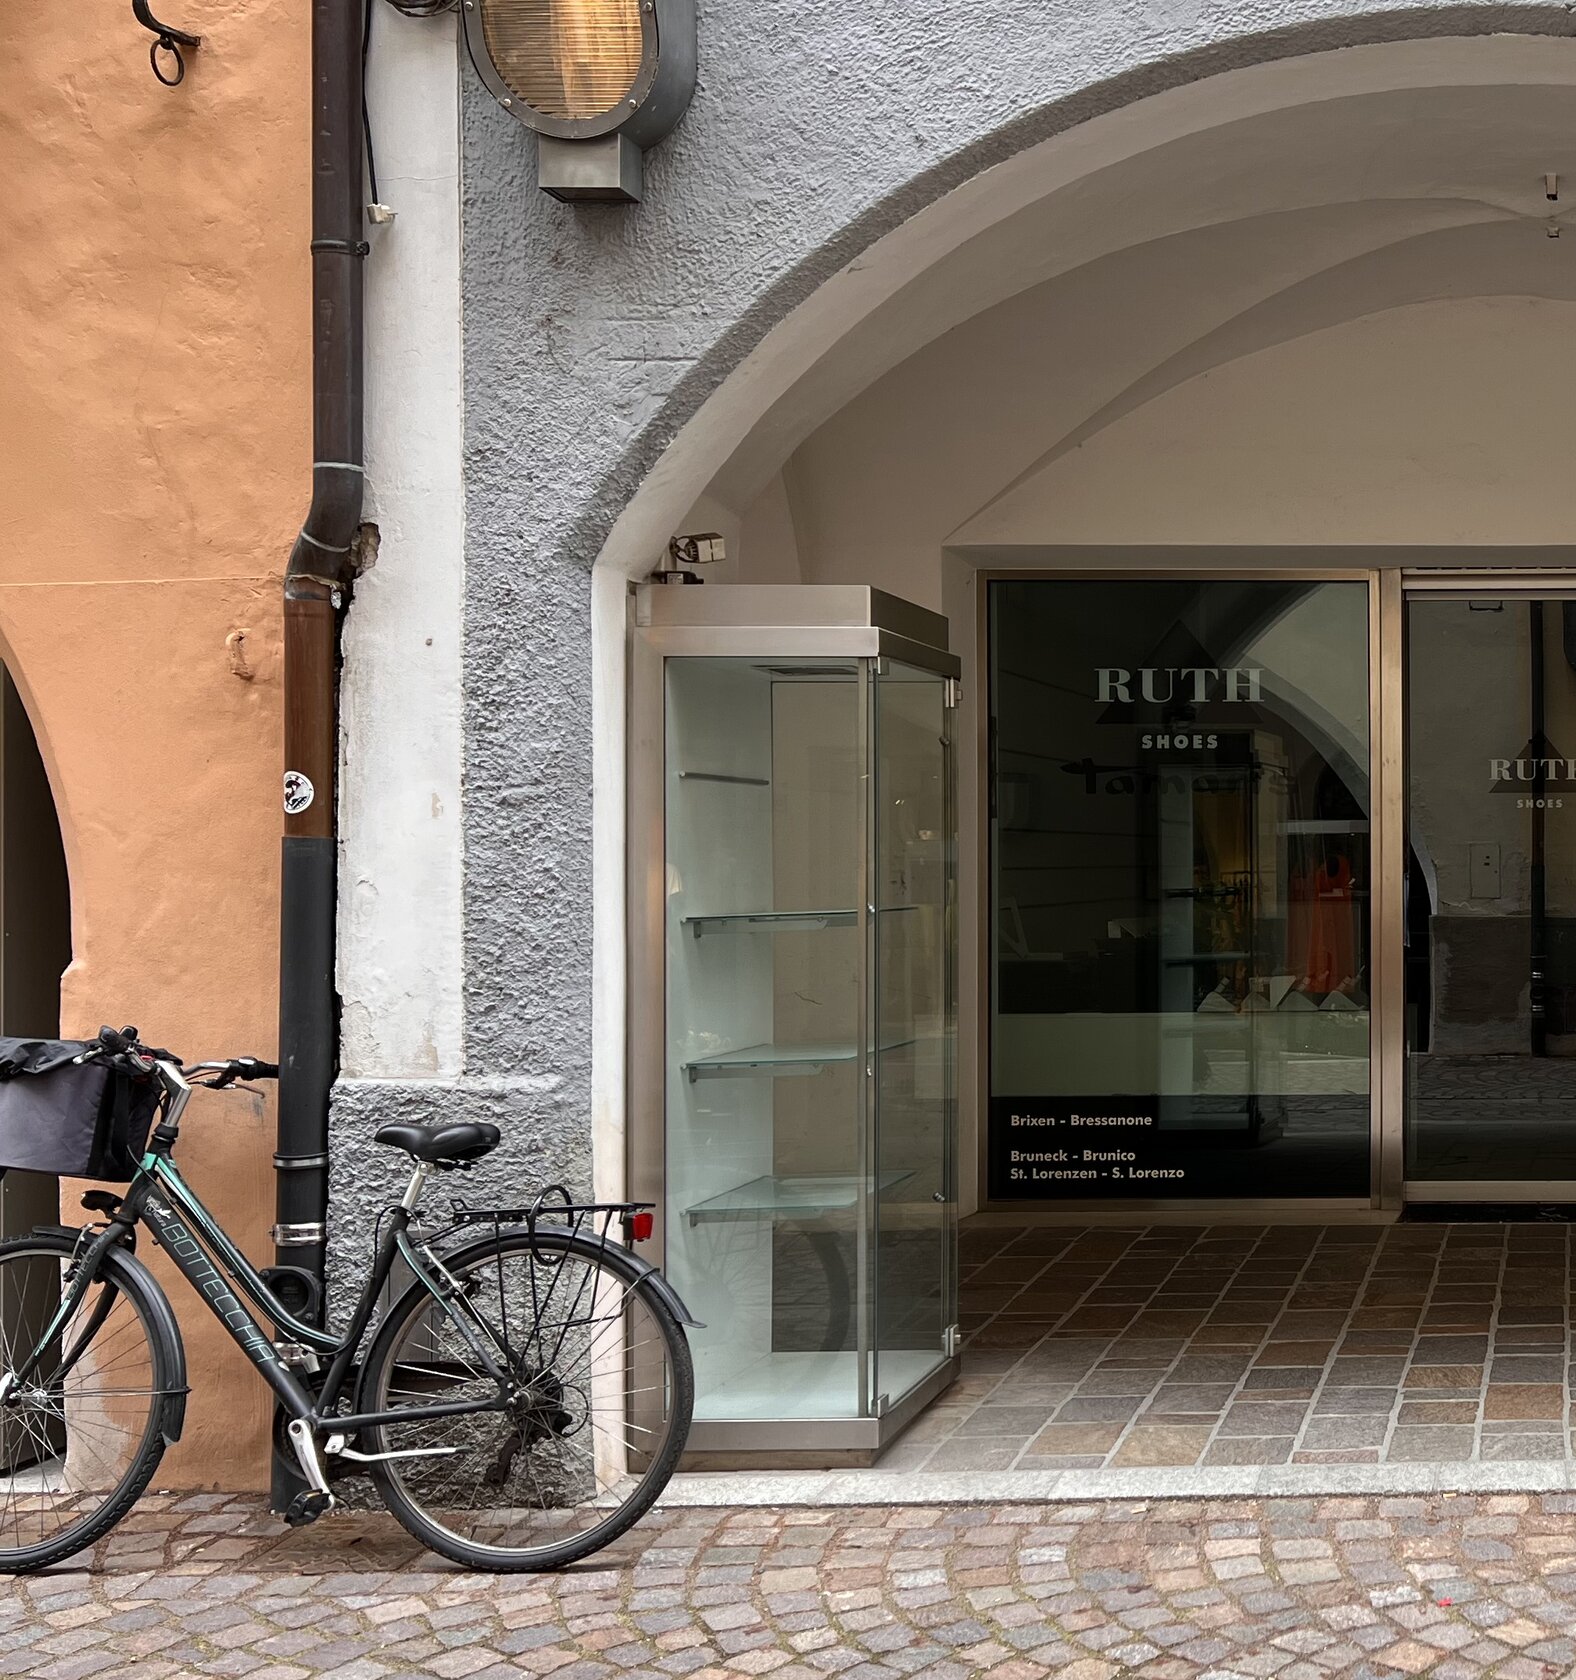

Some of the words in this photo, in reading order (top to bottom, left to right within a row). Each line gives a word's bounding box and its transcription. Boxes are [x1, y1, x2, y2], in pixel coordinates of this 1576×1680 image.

[1094, 668, 1264, 704] RUTH
[1142, 734, 1219, 750] SHOES
[1516, 798, 1564, 809] SHOES
[1011, 1114, 1055, 1126] Brixen
[1070, 1114, 1153, 1126] Bressanone
[1010, 1149, 1068, 1162] Bruneck
[1083, 1149, 1136, 1161] Brunico
[1010, 1168, 1028, 1180] St.
[1032, 1167, 1097, 1179] Lorenzen
[1112, 1167, 1125, 1179] S.
[1128, 1167, 1185, 1179] Lorenzo
[161, 1223, 275, 1363] BOTTECCHIA
